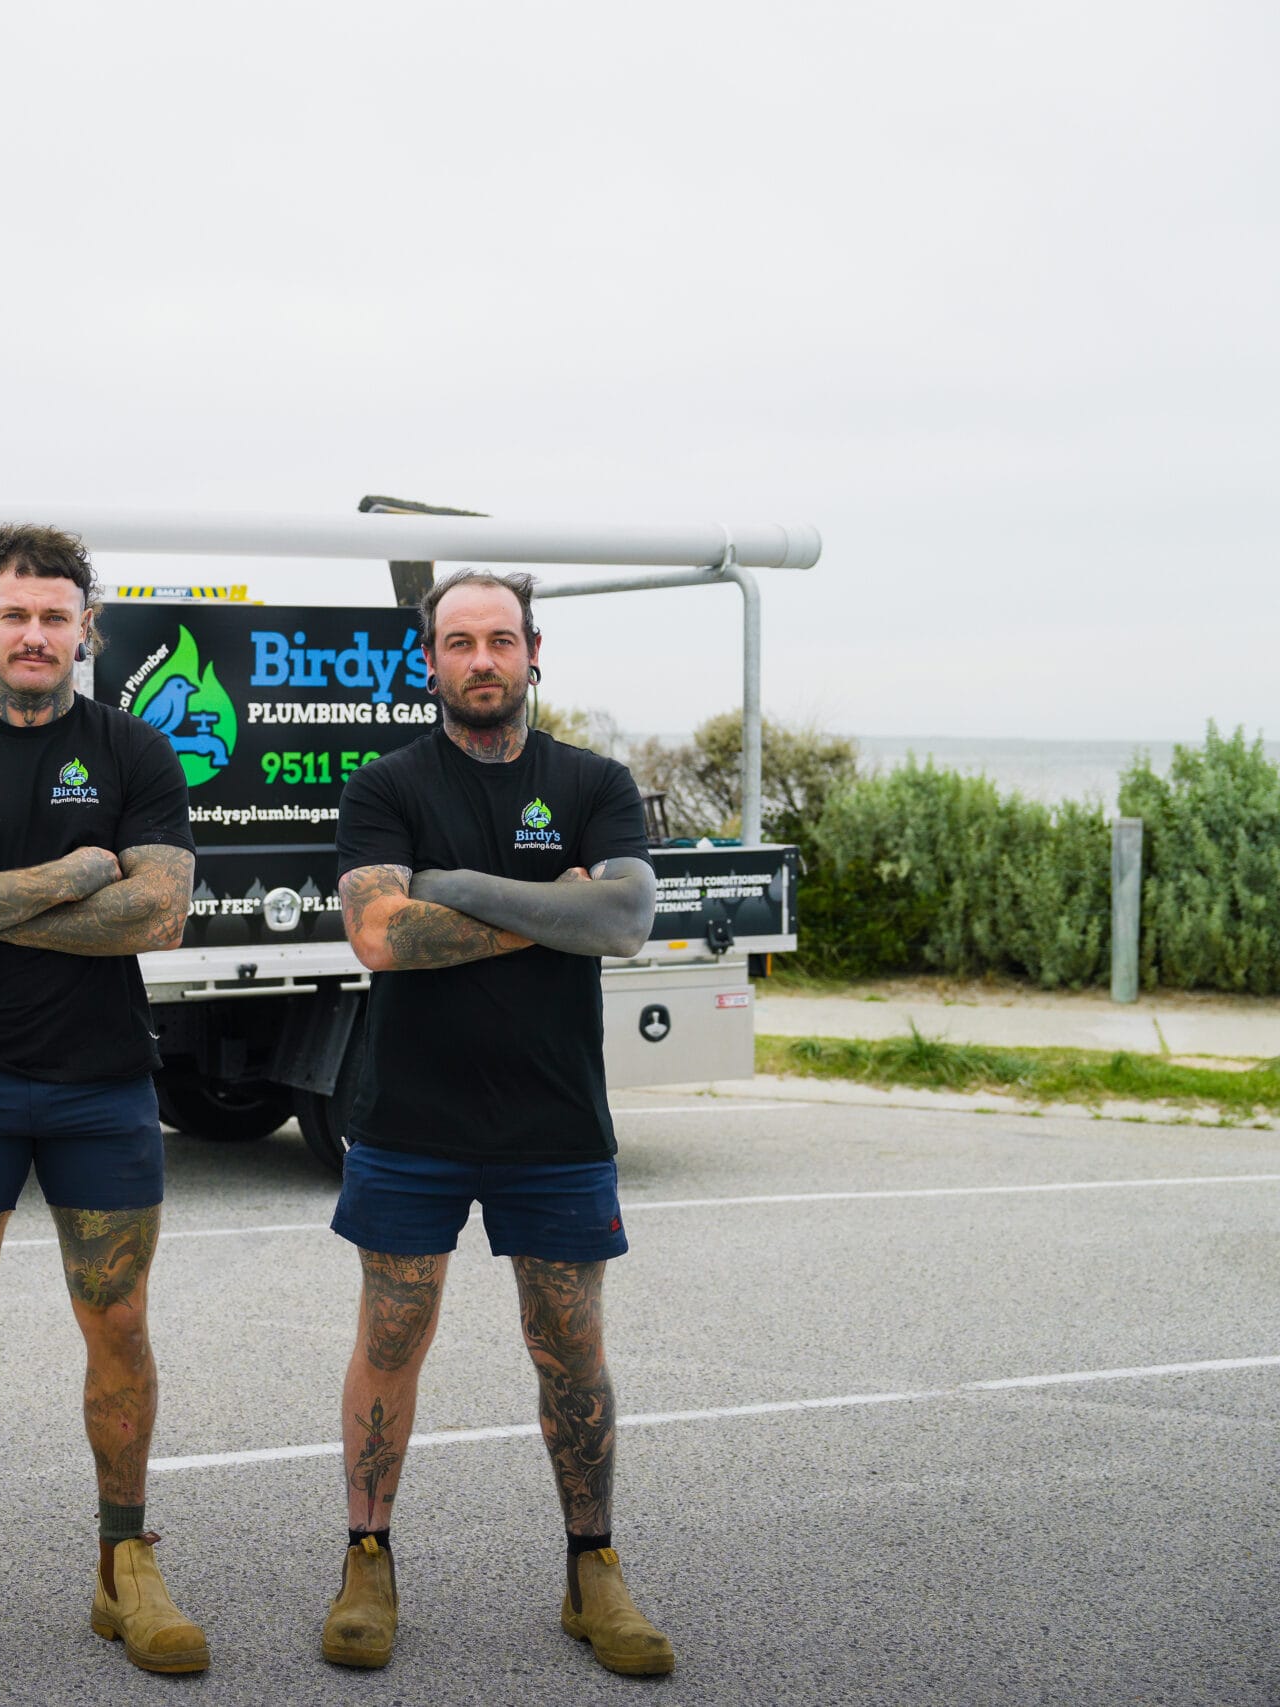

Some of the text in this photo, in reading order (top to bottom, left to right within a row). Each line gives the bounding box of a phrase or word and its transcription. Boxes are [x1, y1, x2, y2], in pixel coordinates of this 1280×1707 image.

[125, 643, 169, 692] Plumber
[250, 628, 428, 703] Birdy's
[248, 702, 437, 724] PLUMBING & GAS
[261, 752, 333, 784] 9511
[52, 786, 98, 798] Birdy's
[515, 829, 561, 843] Birdy's
[704, 874, 772, 886] CONDITIONING
[303, 896, 325, 912] PL
